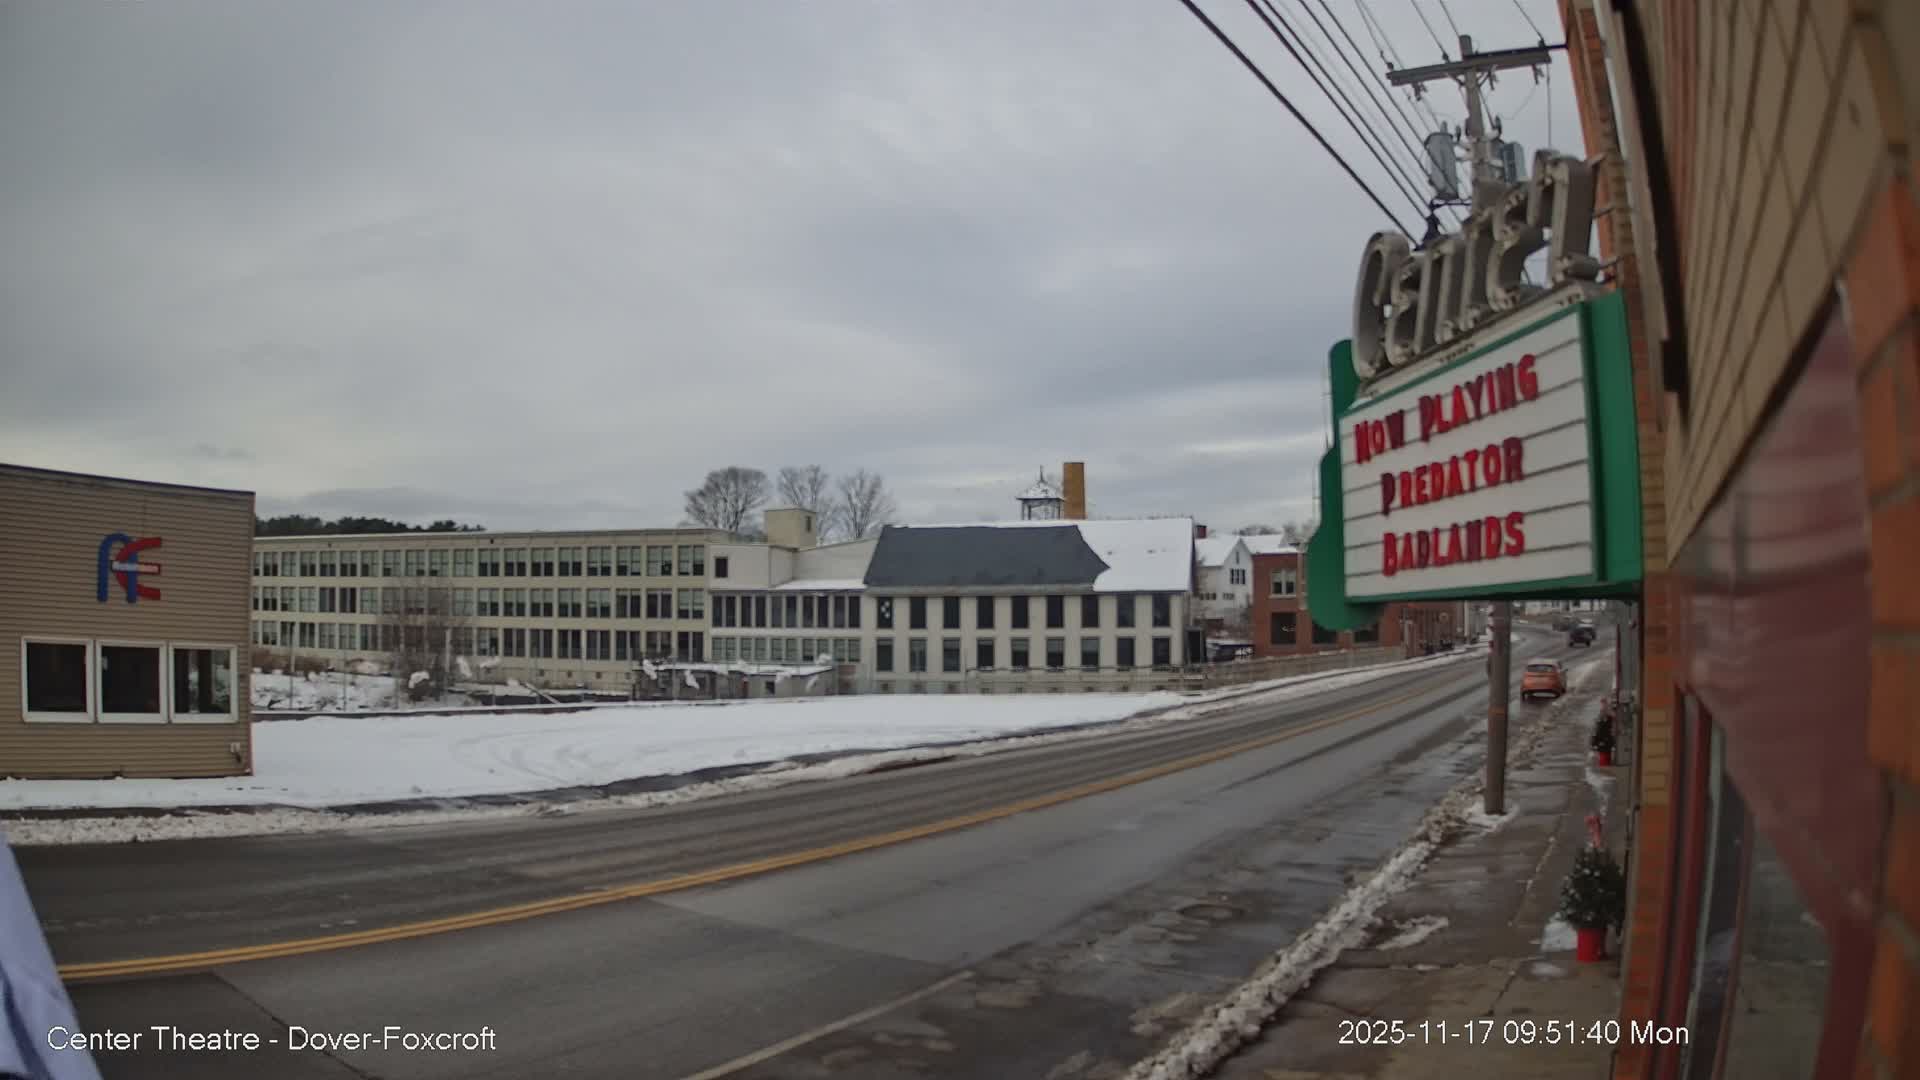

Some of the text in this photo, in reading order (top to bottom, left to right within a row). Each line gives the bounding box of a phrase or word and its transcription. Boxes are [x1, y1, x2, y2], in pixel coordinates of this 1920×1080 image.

[1355, 353, 1539, 464] NOW PLAYING
[1380, 436, 1525, 516] PREDATOR
[1382, 511, 1525, 577] BADLANDS
